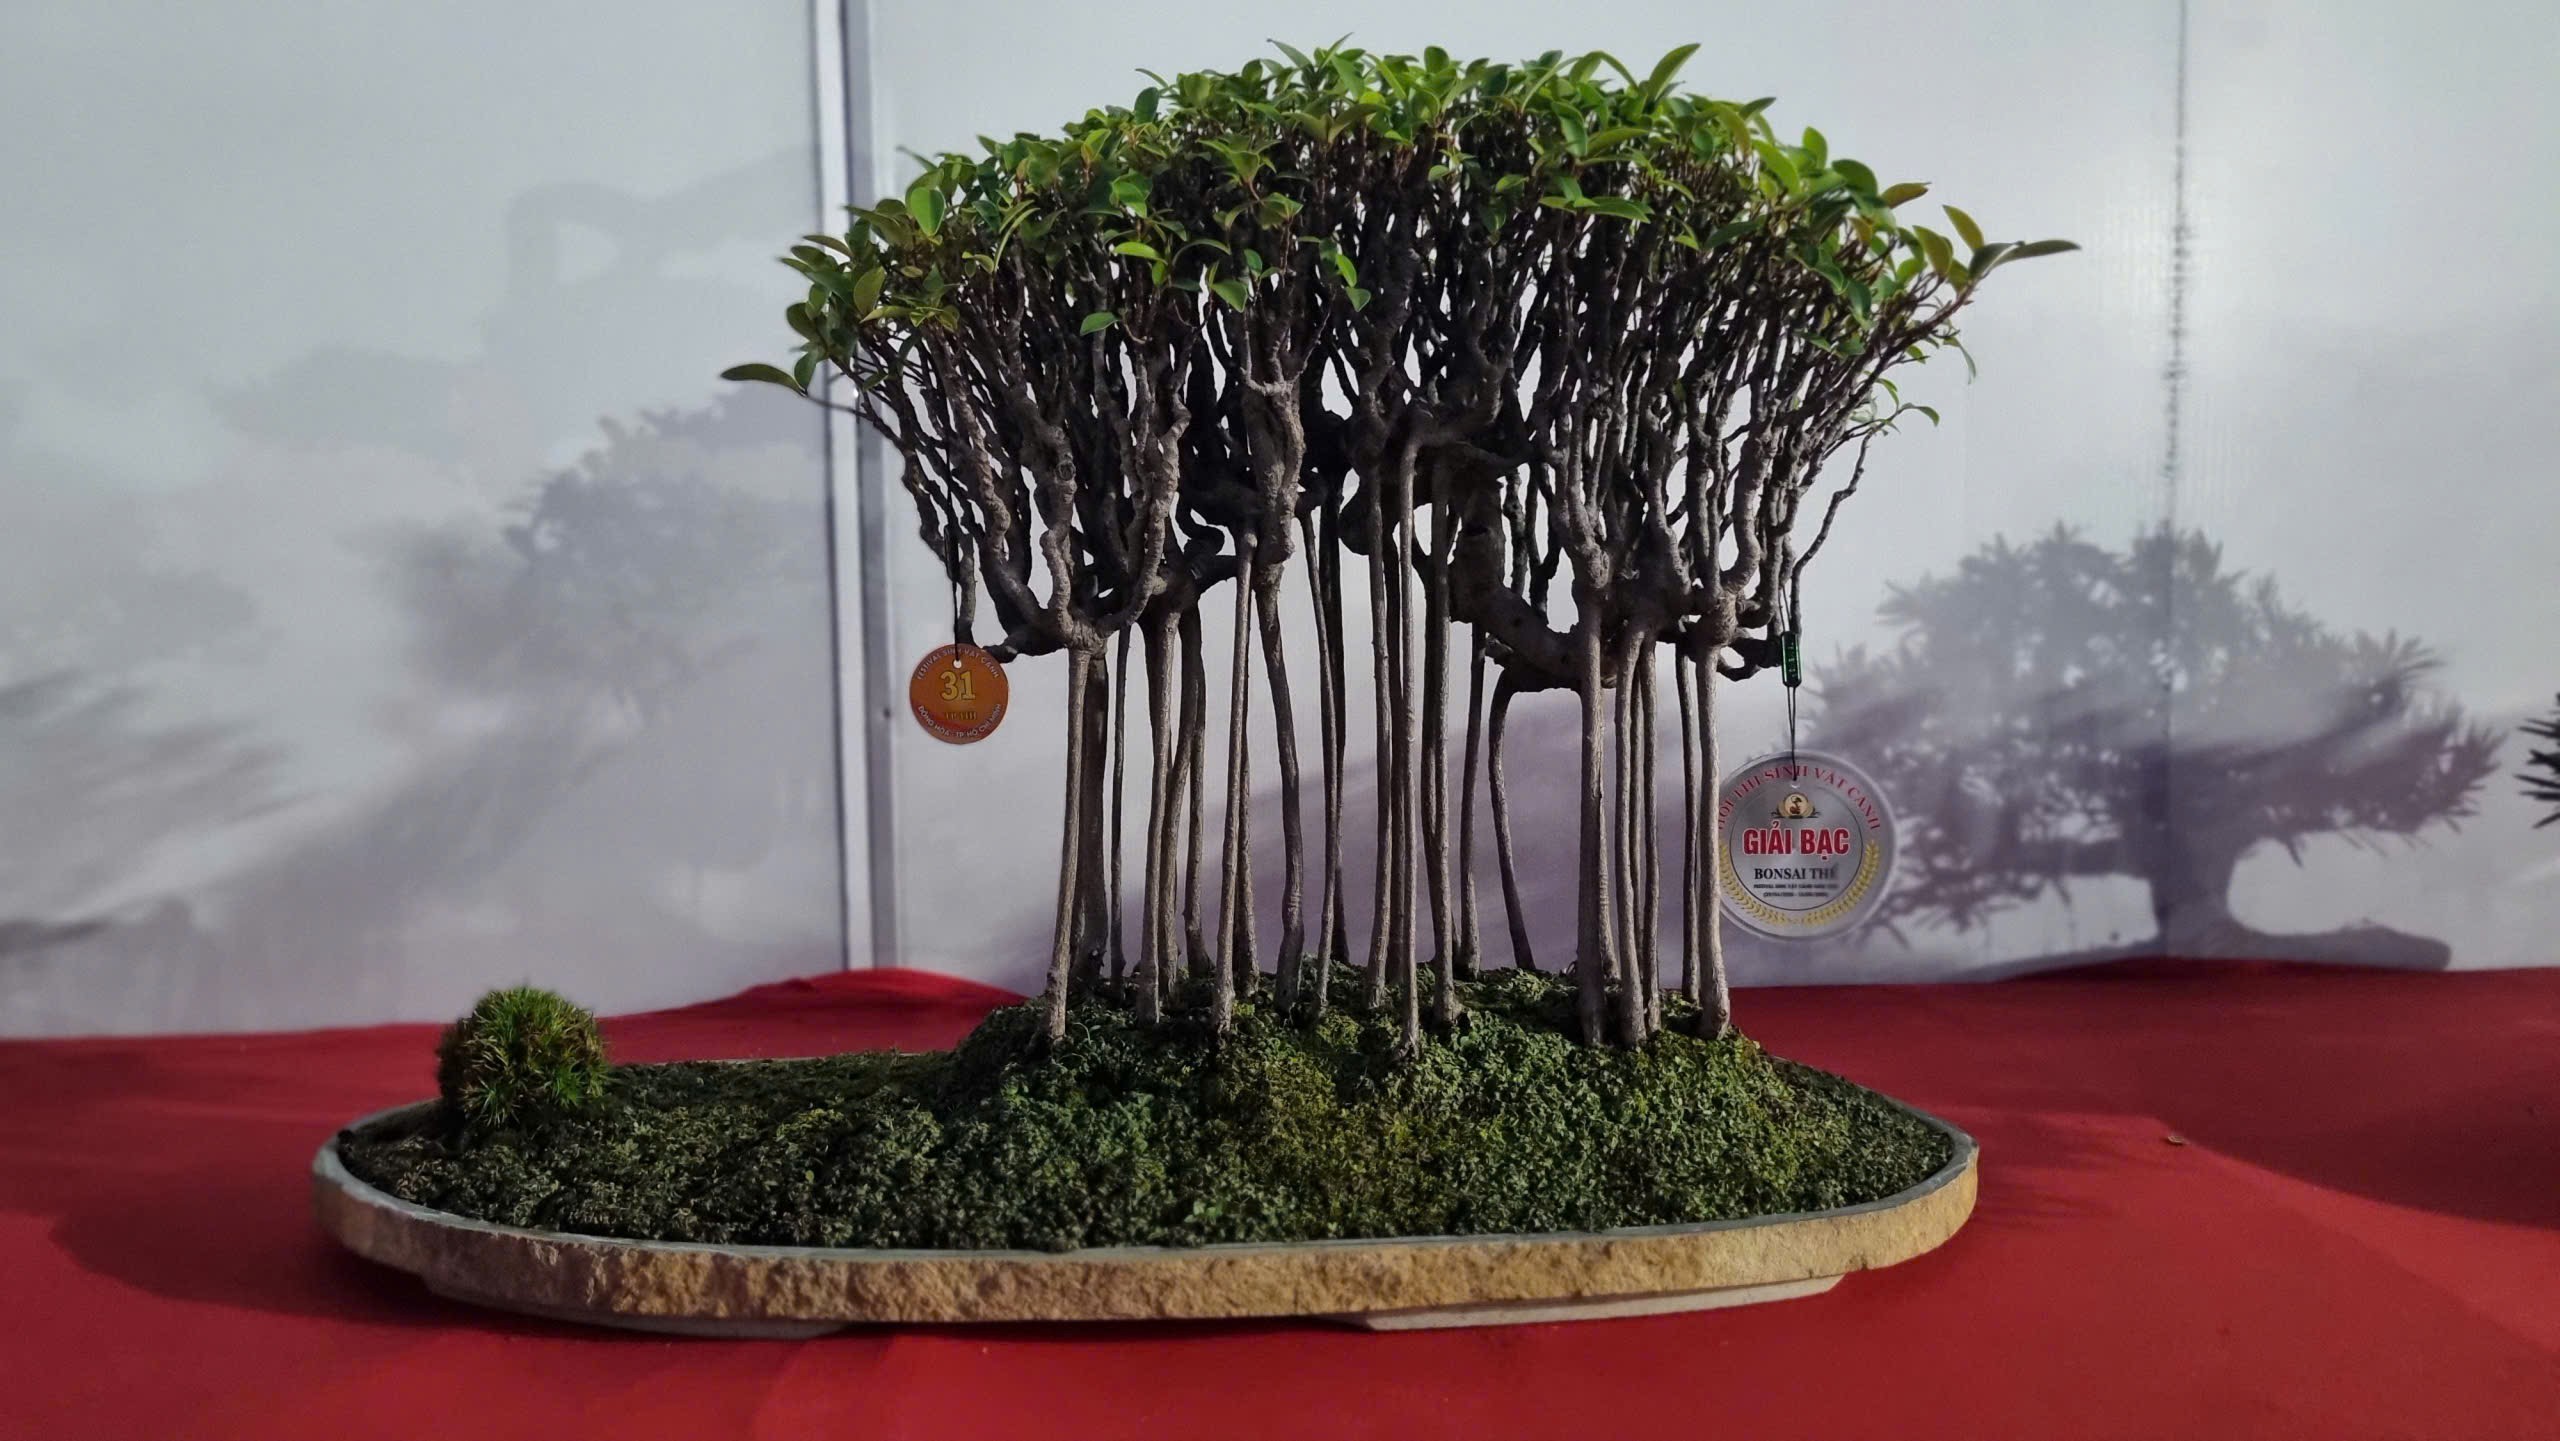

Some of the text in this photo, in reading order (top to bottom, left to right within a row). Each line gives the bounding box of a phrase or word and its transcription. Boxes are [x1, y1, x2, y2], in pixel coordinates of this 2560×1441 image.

[917, 653, 942, 681] FESTIVAL
[940, 670, 976, 701] 31
[1764, 765, 1808, 779] SINH
[1743, 819, 1850, 862] GIẢI BẠC
[1754, 867, 1806, 880] BONSAI
